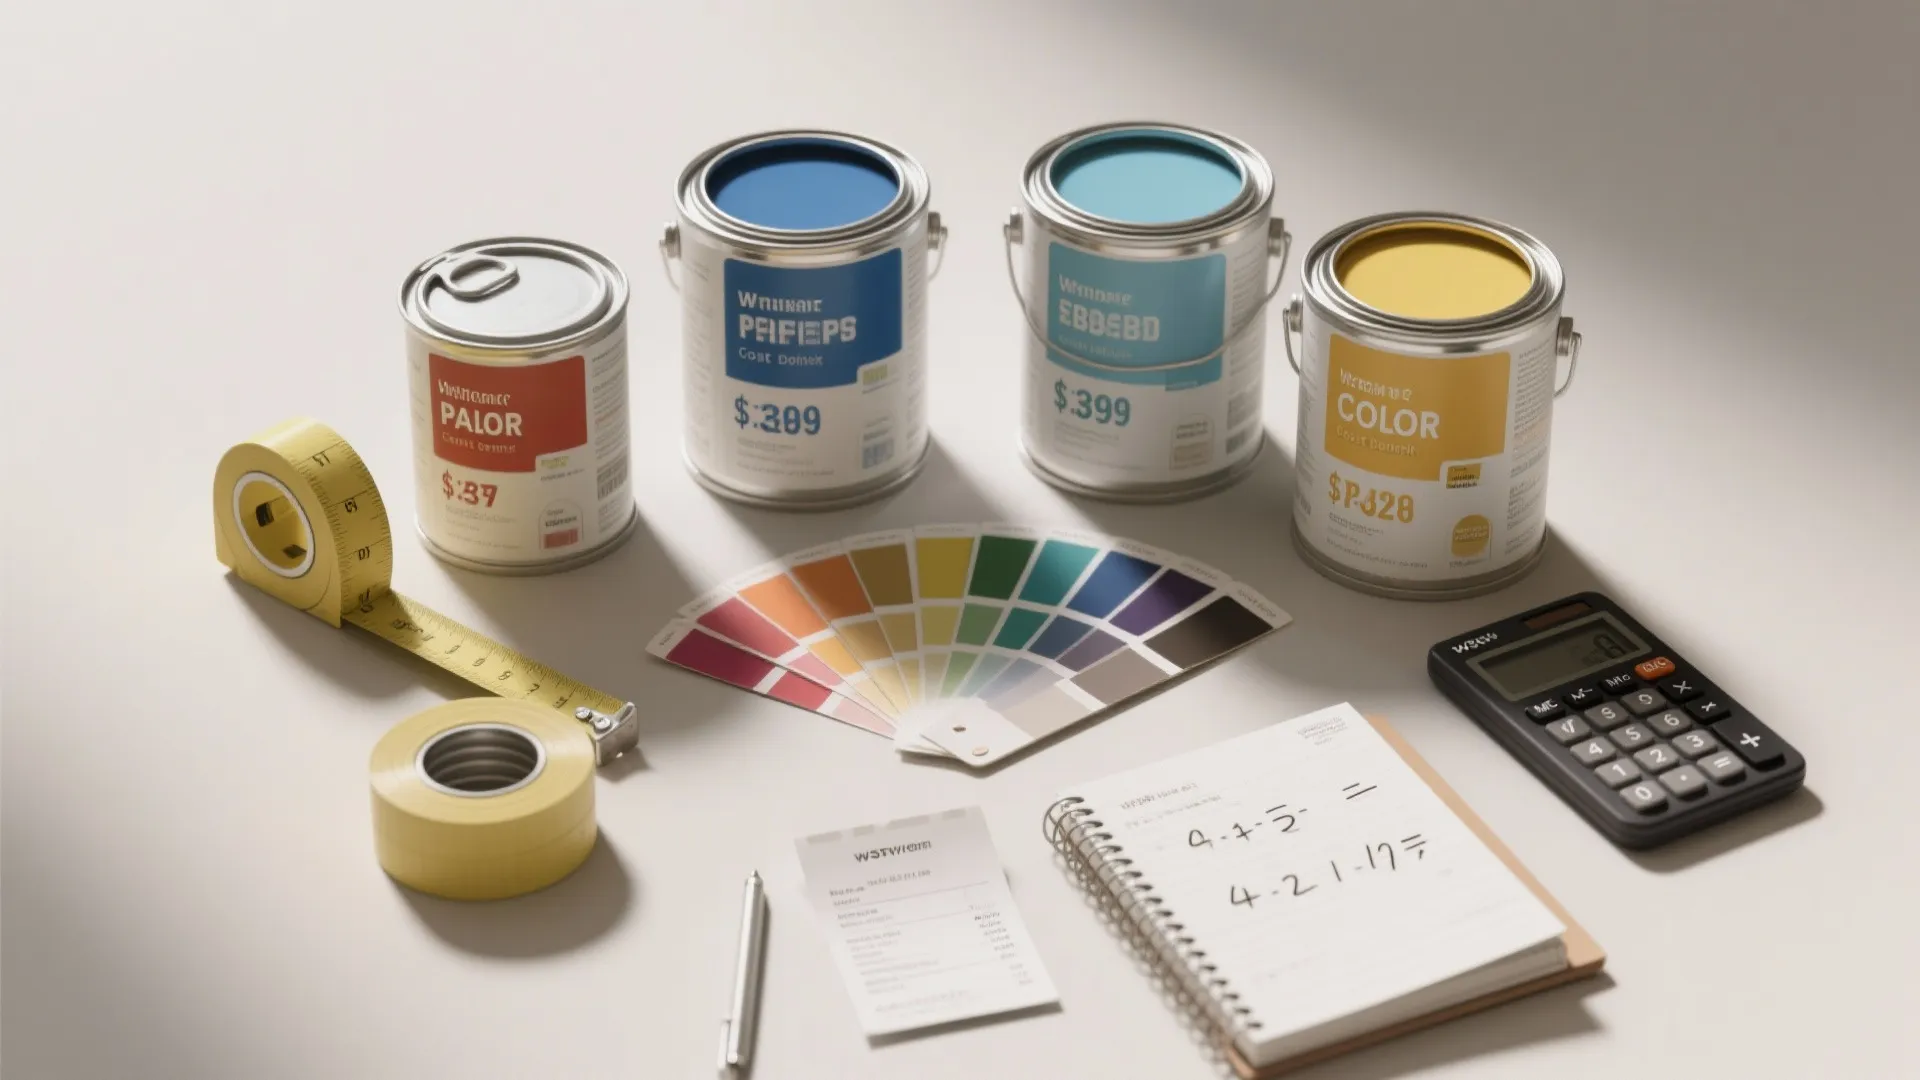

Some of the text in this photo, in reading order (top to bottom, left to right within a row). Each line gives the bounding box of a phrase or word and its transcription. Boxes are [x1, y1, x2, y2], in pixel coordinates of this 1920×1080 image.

[440, 401, 523, 438] PALOR
[1337, 392, 1441, 440] COLOR
[1663, 713, 1680, 727] 6
[1625, 726, 1642, 742] 5
[1687, 734, 1705, 749] 3
[1588, 742, 1604, 757] 4
[1650, 749, 1667, 764] 2
[1611, 763, 1627, 778] 1
[1635, 785, 1653, 801] 0
